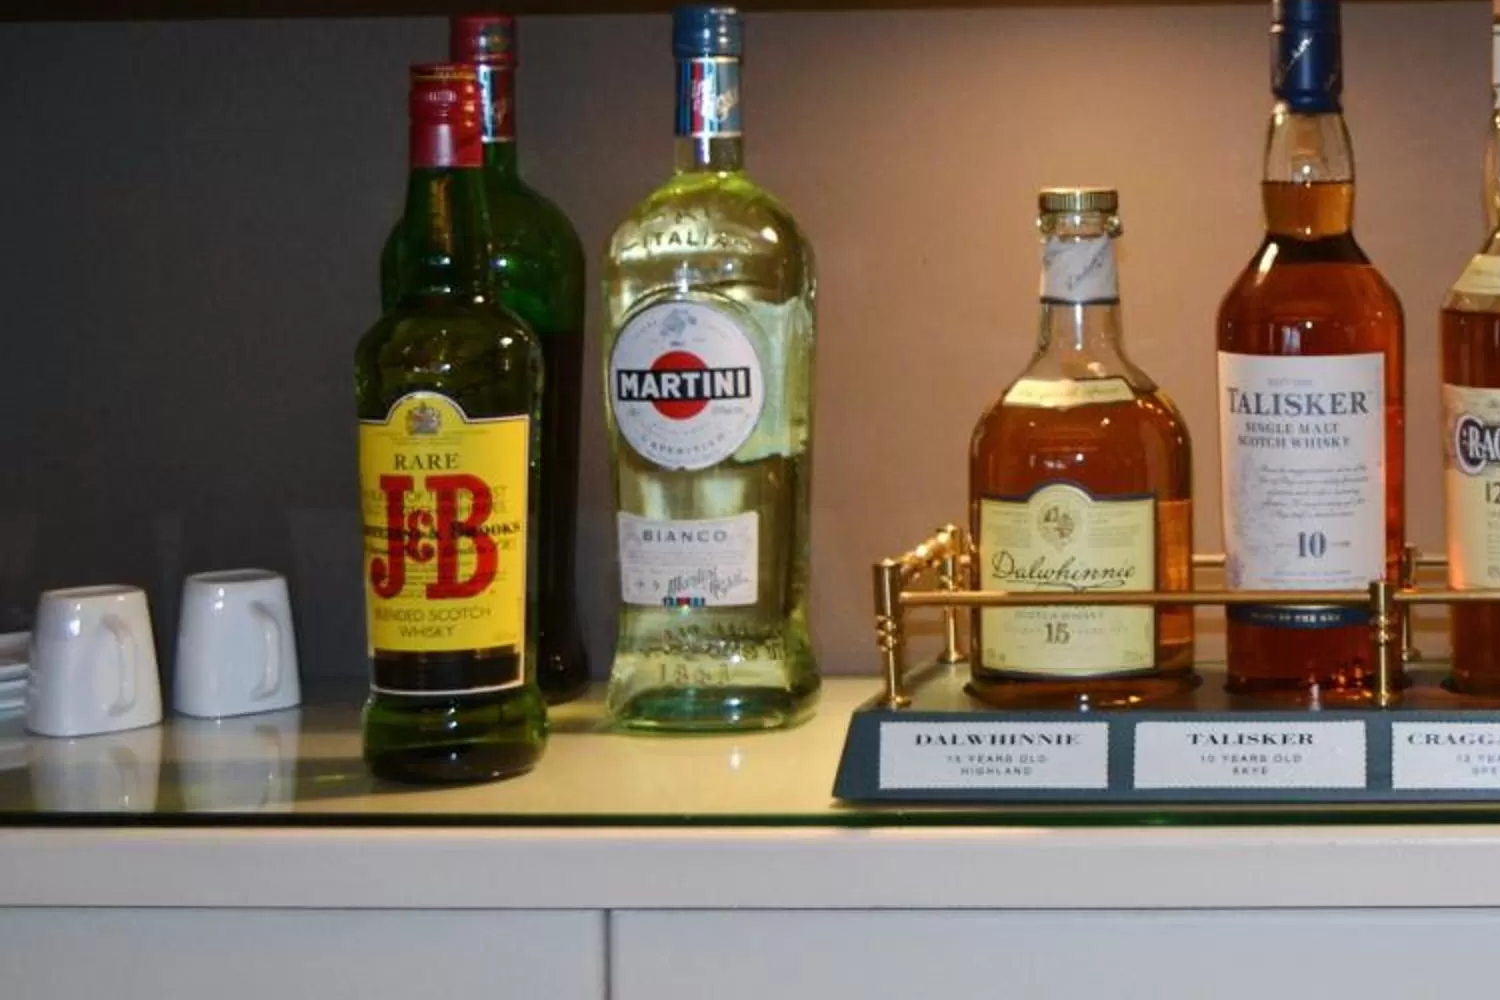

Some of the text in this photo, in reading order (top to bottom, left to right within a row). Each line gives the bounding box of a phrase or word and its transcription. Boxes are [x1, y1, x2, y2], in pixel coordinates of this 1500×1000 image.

[619, 369, 749, 400] MARTINI
[1227, 386, 1371, 417] TALISKER
[393, 452, 460, 471] RARE
[641, 528, 729, 543] BIANCO
[1296, 530, 1328, 558] 10
[427, 606, 492, 622] SCOTCH
[399, 624, 457, 638] WHISKY
[1044, 622, 1071, 645] 15
[914, 732, 1083, 746] DALWHINNIE
[1186, 732, 1314, 746] TALISKER
[967, 753, 1049, 764] YEARS OLD
[1221, 753, 1268, 764] YEARS
[1273, 753, 1304, 764] OLD
